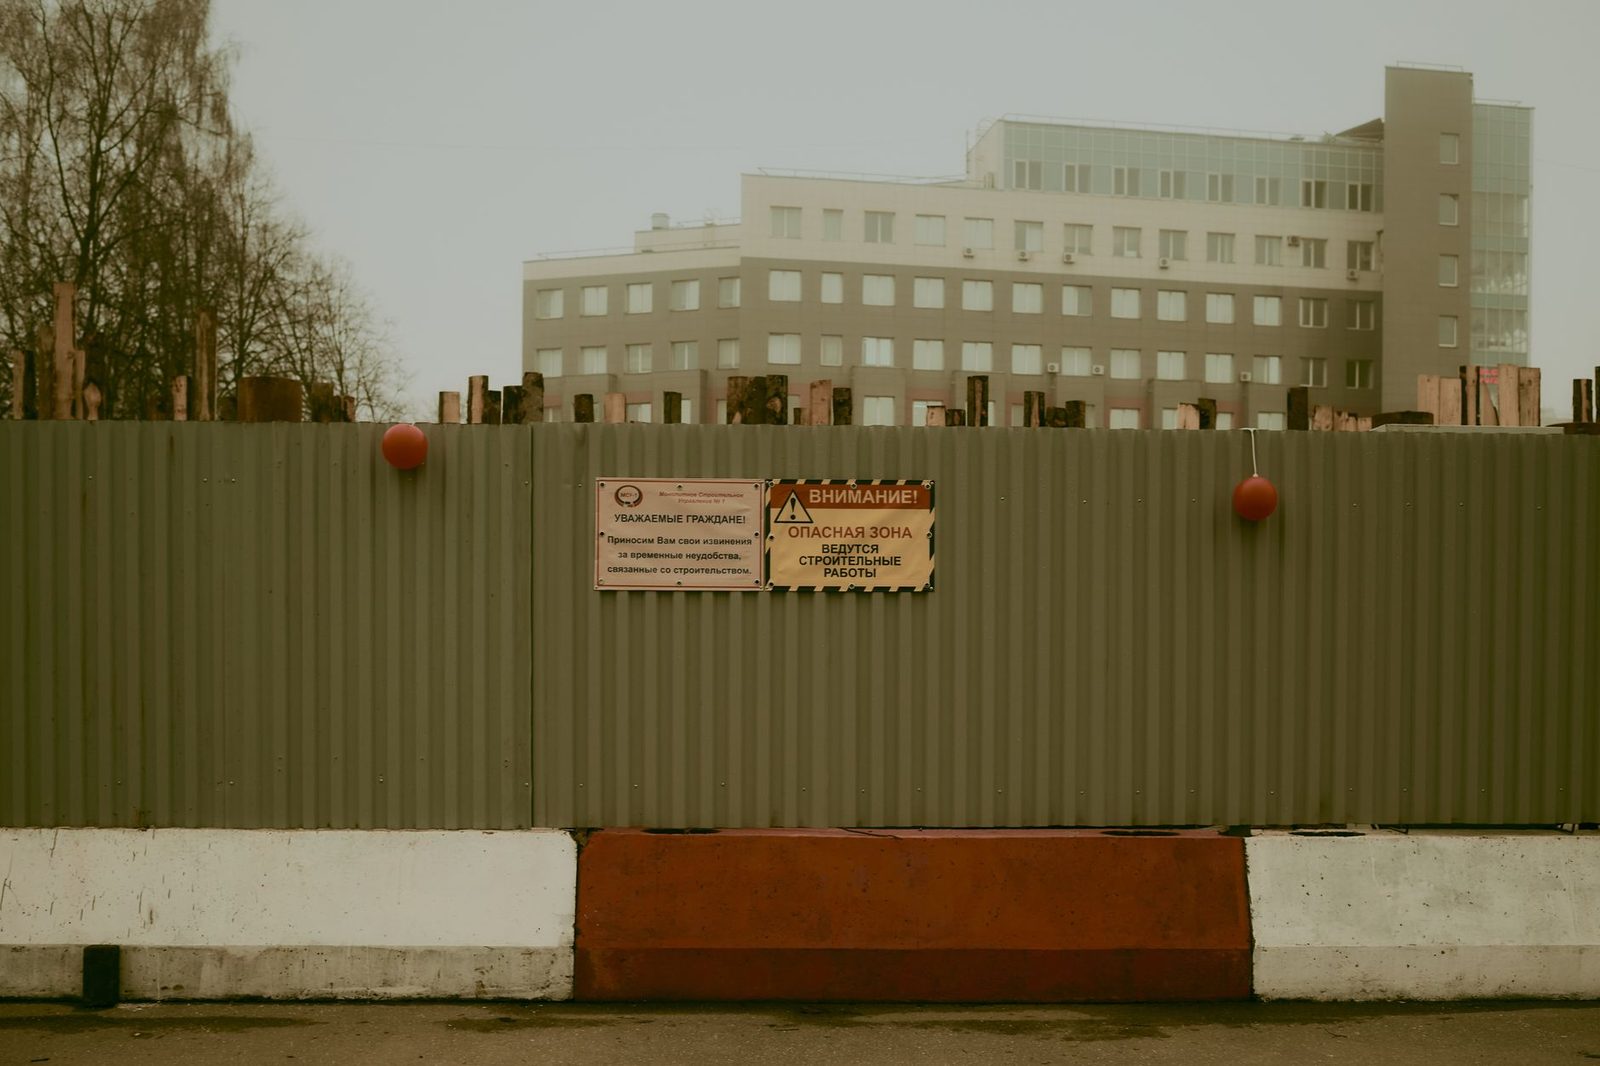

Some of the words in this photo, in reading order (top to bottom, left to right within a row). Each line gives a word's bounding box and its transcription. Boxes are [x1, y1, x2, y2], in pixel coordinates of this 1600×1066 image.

[809, 489, 917, 504] ВНИМАНИЕ!
[615, 514, 682, 523] УВАЖАЕМЫЕ
[687, 515, 745, 525] ГРАЖДАНЕ!
[789, 526, 864, 538] ОПАСНАЯ
[870, 527, 912, 538] ЗОНА
[608, 536, 654, 545] Приносим
[658, 536, 675, 544] Вам
[822, 544, 878, 555] ВЕДУТСЯ
[631, 552, 682, 560] временные
[686, 551, 741, 561] неудобства,
[799, 556, 901, 566] СТРОИТЕЛЬНЫЕ
[608, 566, 657, 574] связанные
[674, 567, 751, 575] строительством.
[824, 568, 876, 577] РАБОТЫ
